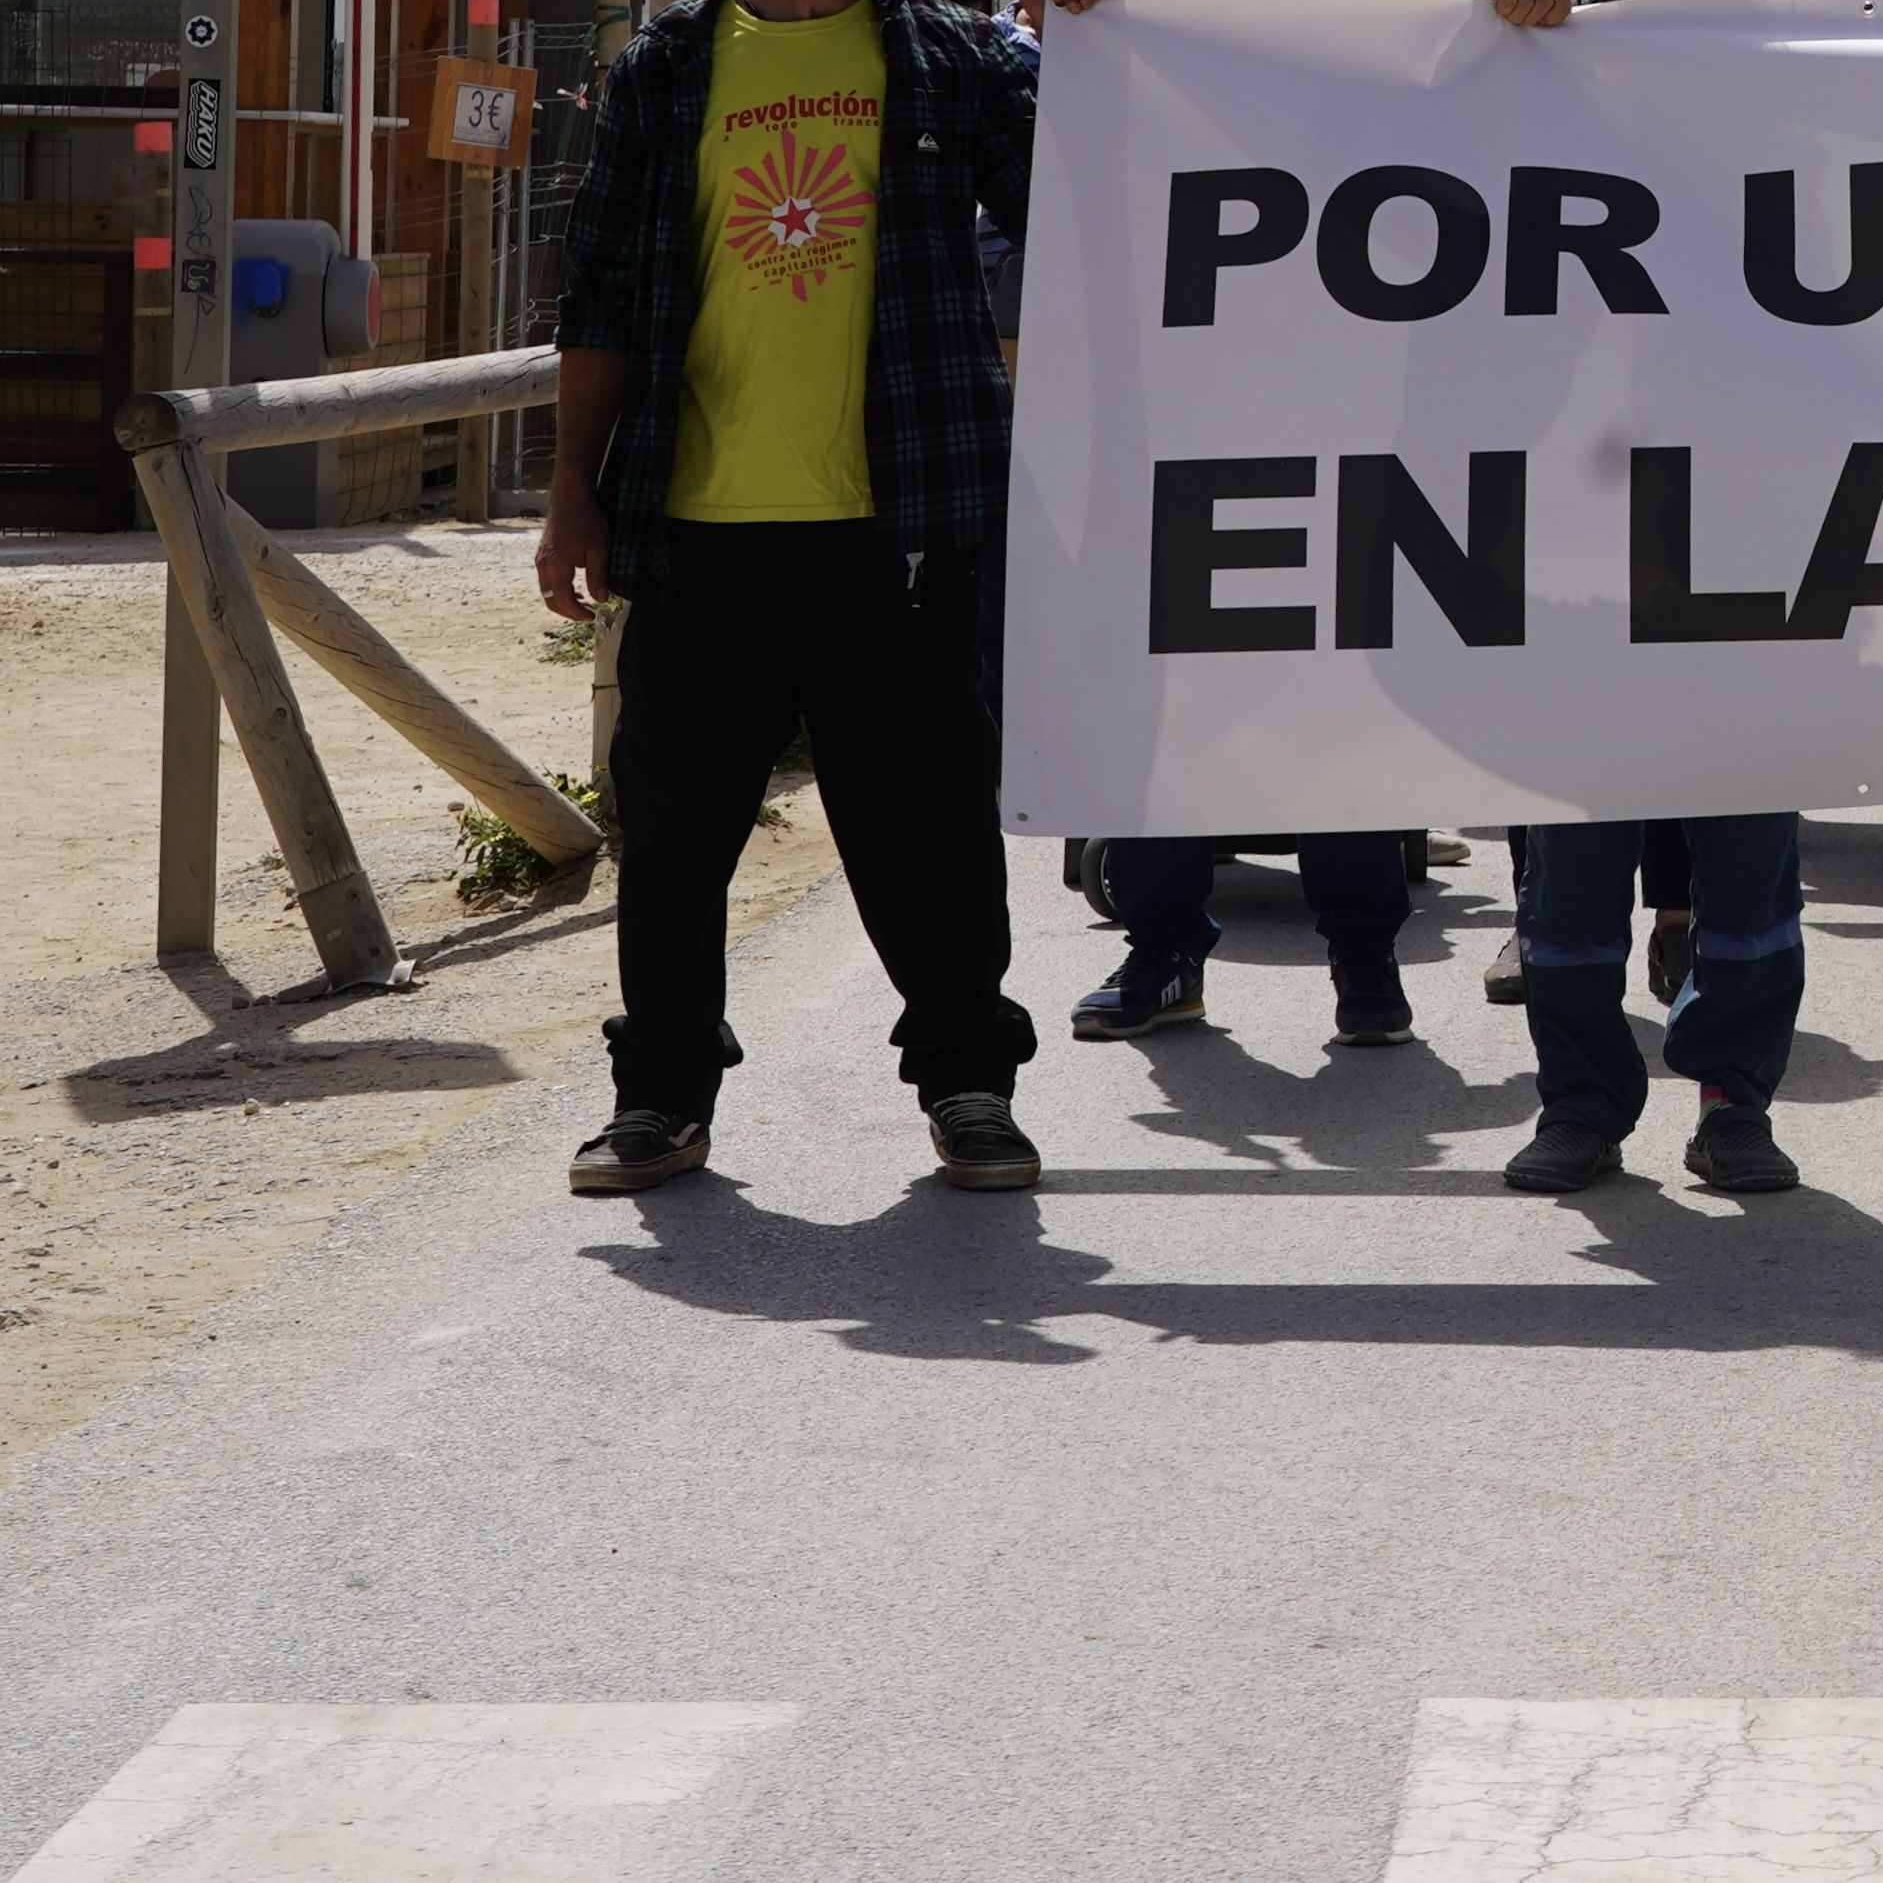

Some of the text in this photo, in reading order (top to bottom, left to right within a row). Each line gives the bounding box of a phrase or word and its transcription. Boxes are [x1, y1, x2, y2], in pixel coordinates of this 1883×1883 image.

[196, 85, 216, 161] HAKU
[725, 90, 878, 132] revolución
[765, 120, 797, 132] todo
[747, 254, 785, 271] contra
[790, 249, 801, 260] el
[763, 252, 842, 278] capitalista
[1162, 165, 1670, 328] POR
[1149, 450, 1527, 655] EN
